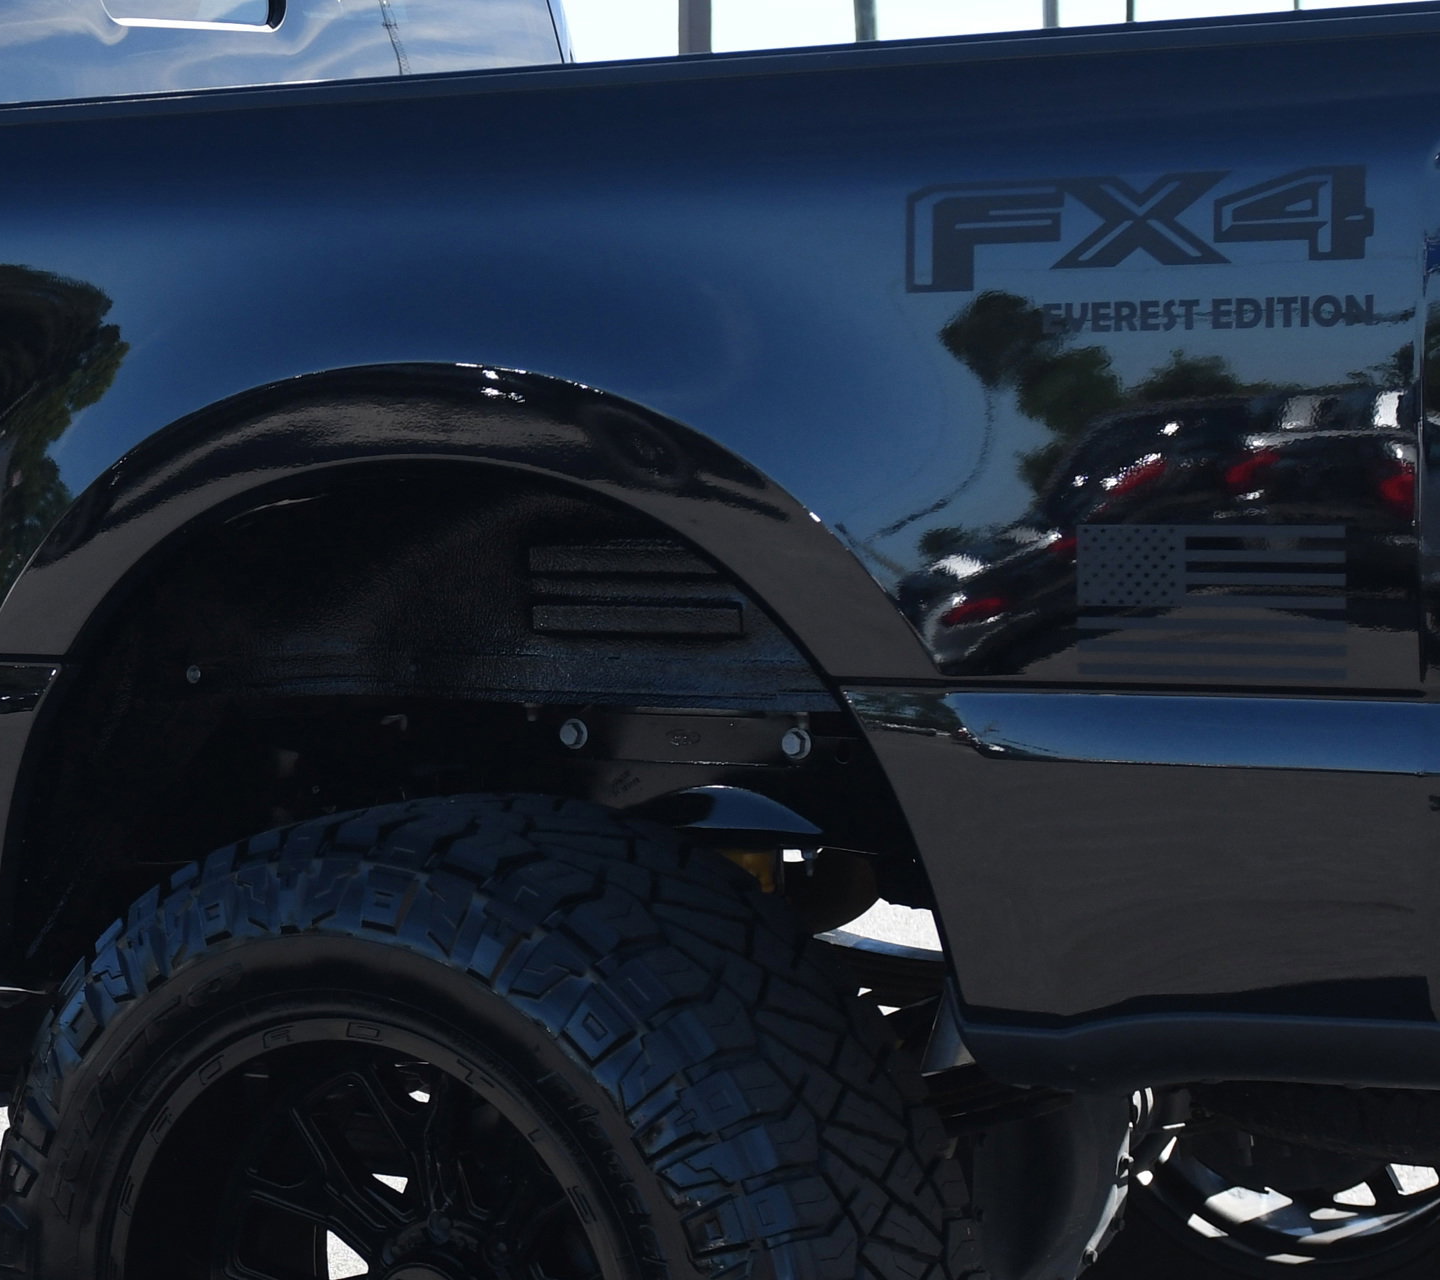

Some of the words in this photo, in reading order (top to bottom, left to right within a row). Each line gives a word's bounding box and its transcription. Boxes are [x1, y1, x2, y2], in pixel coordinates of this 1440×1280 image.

[906, 165, 1374, 293] FX4
[1043, 299, 1201, 333] EVEREST
[1211, 295, 1375, 331] EDITION
